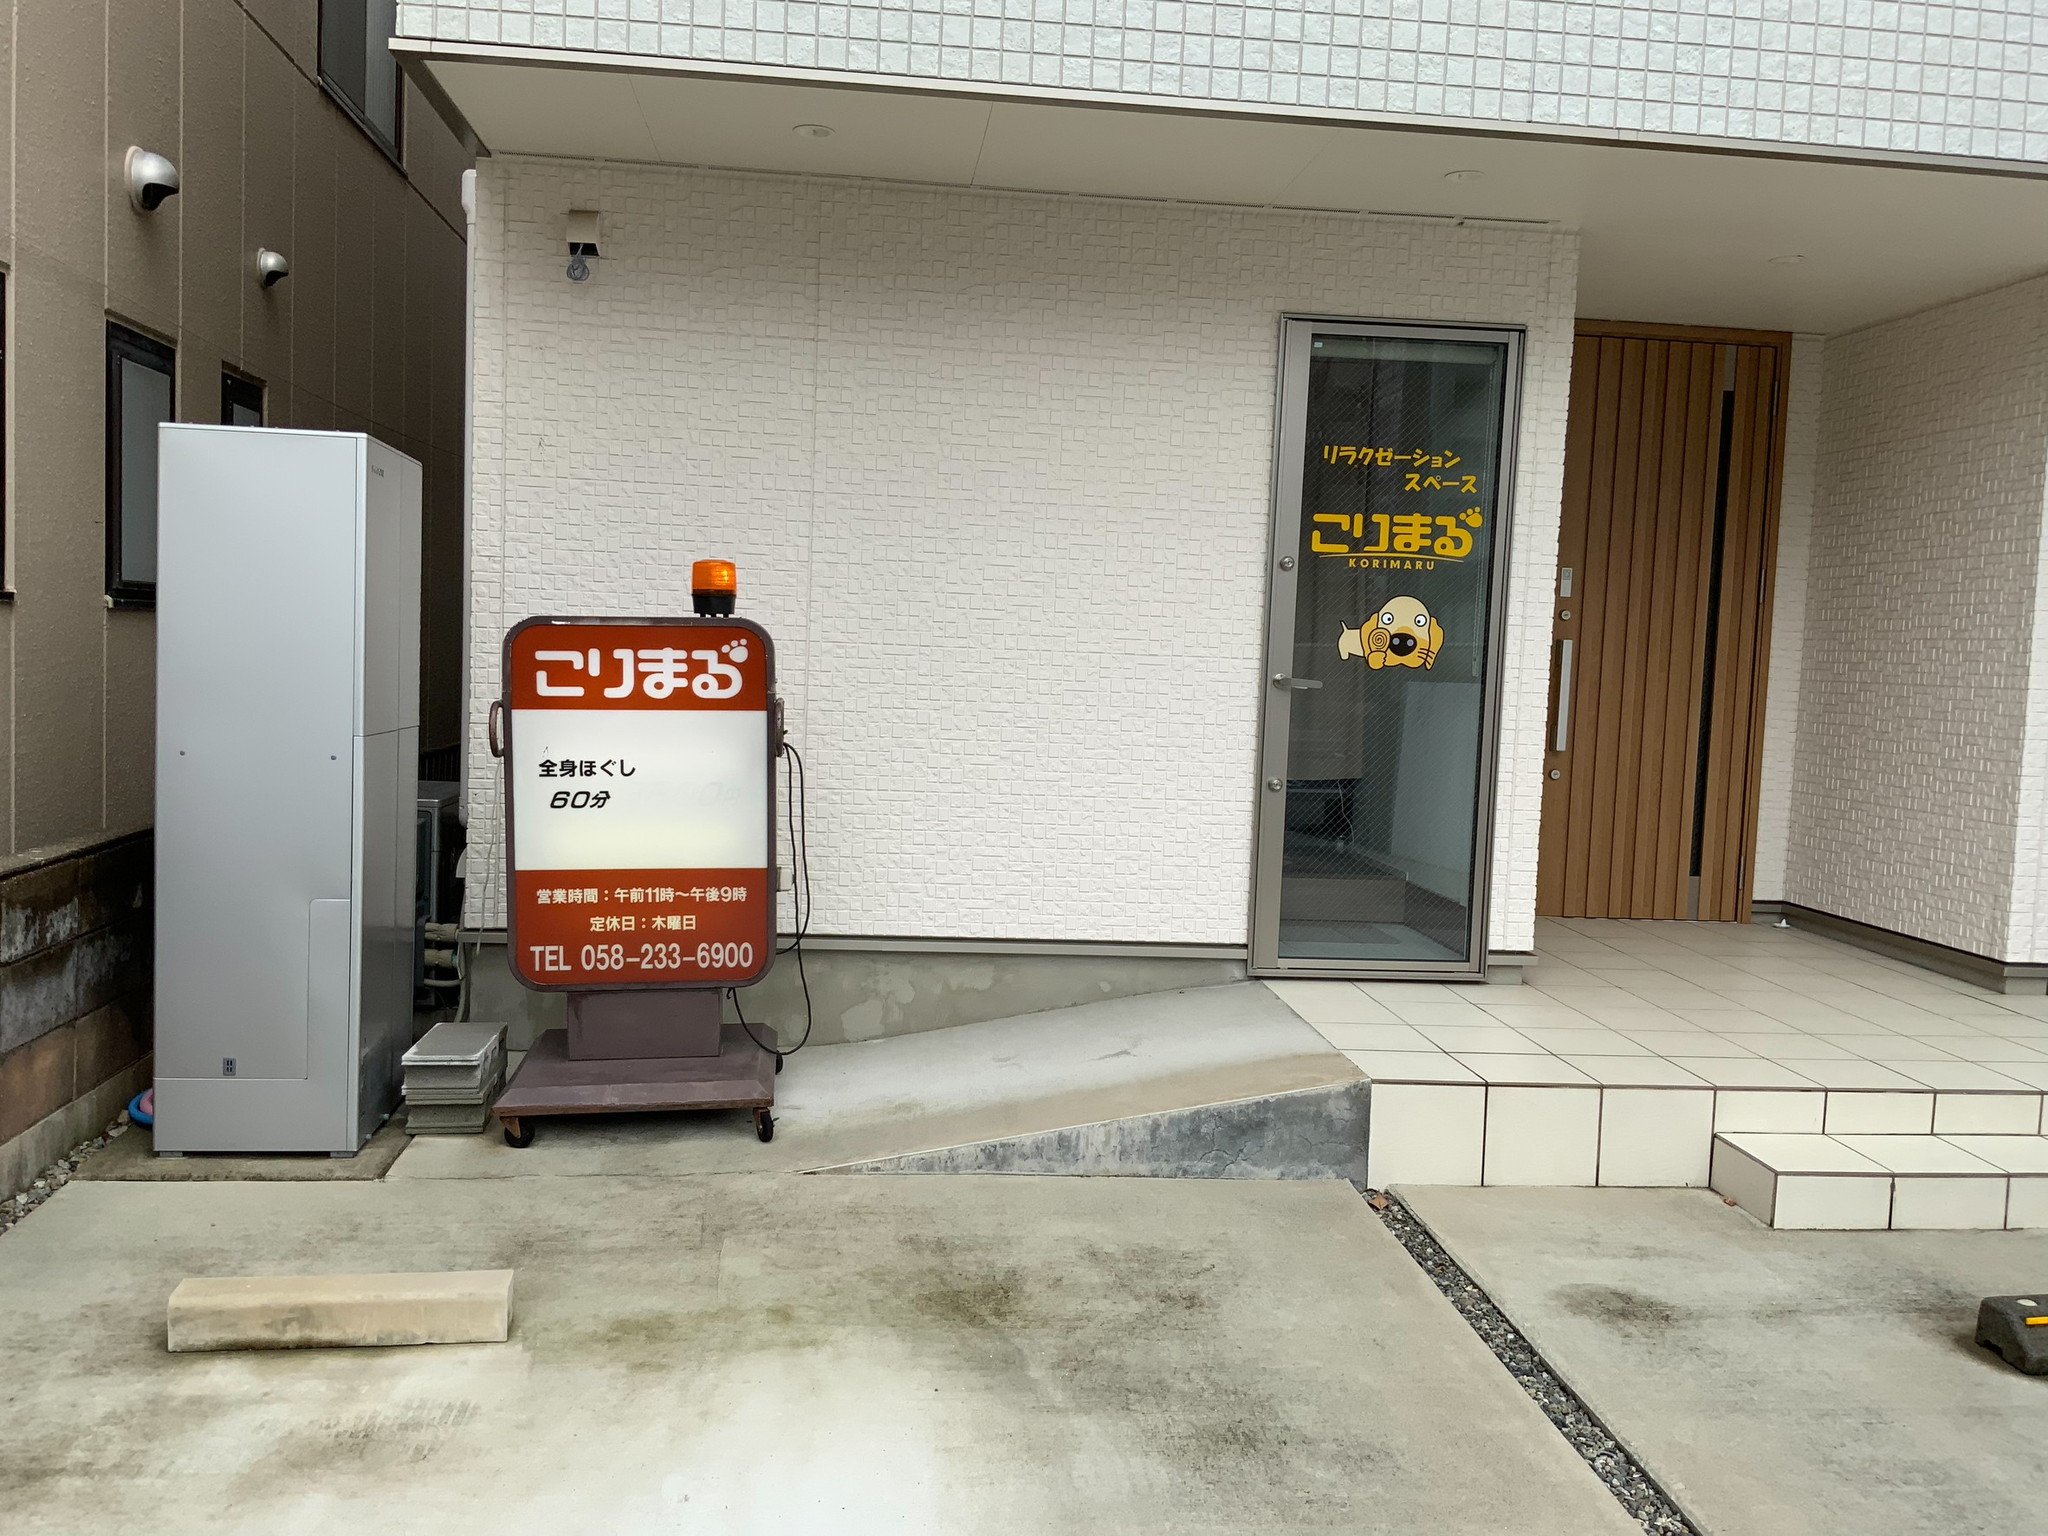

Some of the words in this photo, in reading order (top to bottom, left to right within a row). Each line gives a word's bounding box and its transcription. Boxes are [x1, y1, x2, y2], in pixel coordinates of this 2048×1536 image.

[1323, 445, 1461, 468] リラクゼーション
[1404, 473, 1477, 493] スペース
[1311, 512, 1474, 557] こりまる
[1348, 558, 1435, 570] KORIMARU
[535, 647, 743, 699] こりまる
[539, 759, 635, 777] 全身ほぐし
[550, 791, 610, 808] 60分
[590, 915, 695, 931] 定休日：木曜日
[530, 946, 571, 971] TEL
[581, 942, 752, 970] 058-233-6900
